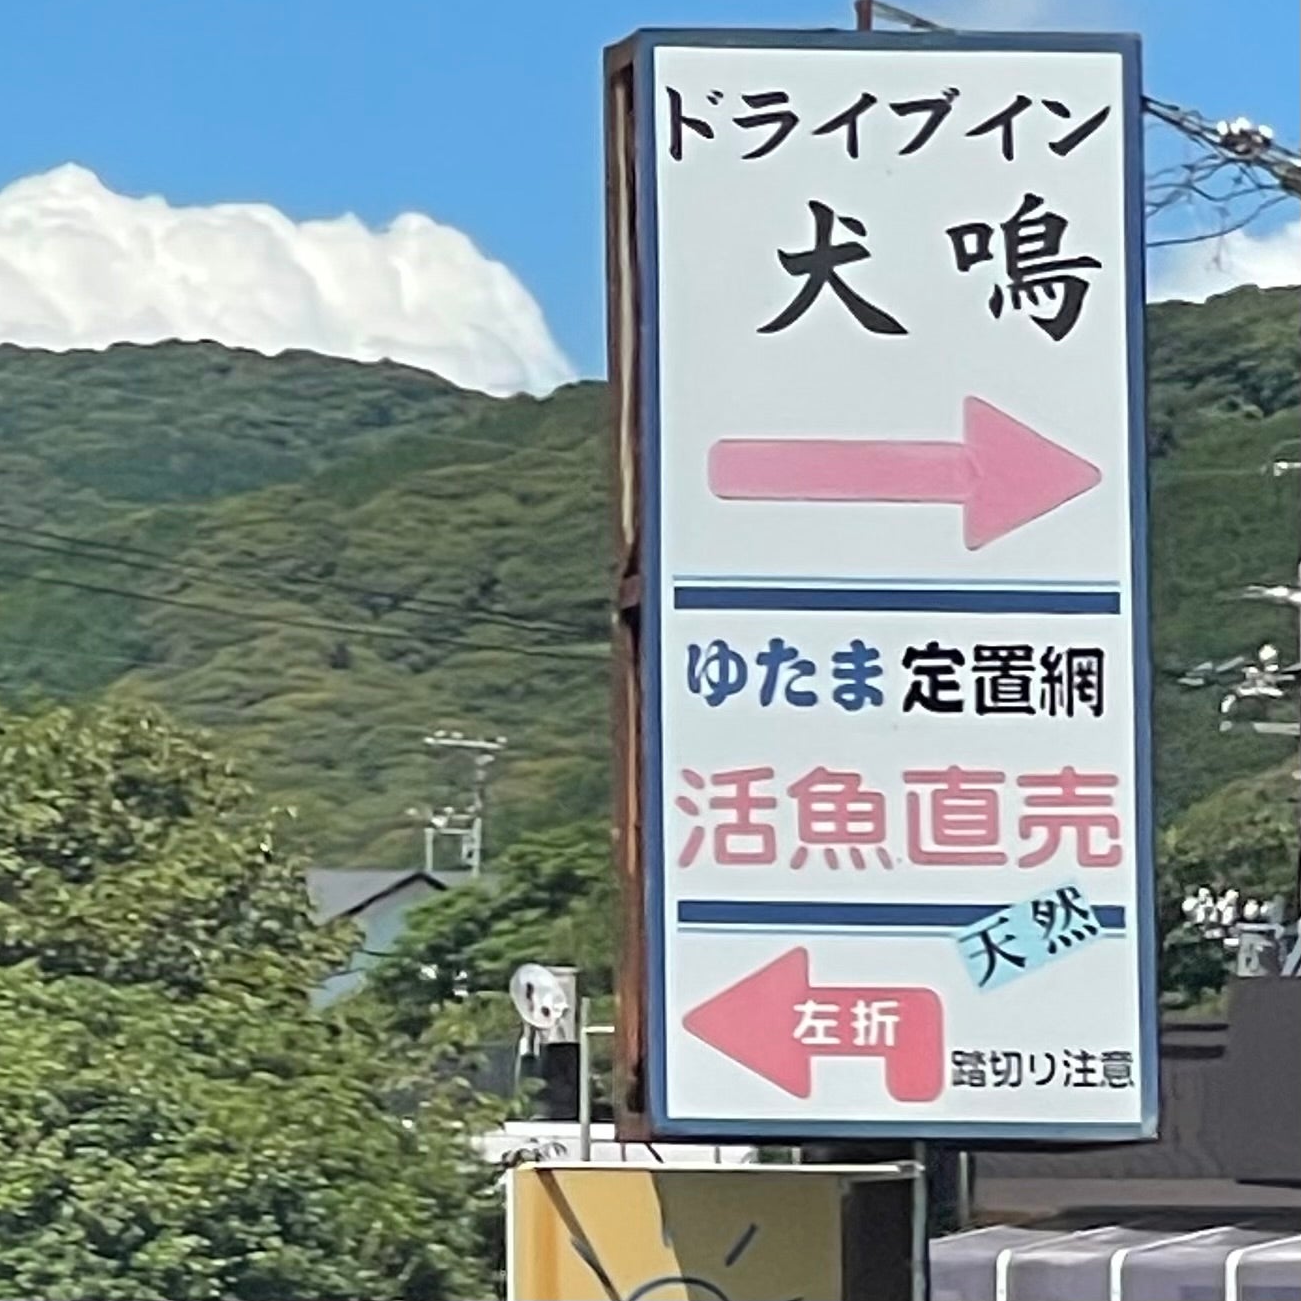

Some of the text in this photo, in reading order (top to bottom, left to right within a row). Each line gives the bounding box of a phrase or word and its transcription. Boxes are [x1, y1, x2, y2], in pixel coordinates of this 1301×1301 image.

[665, 86, 1112, 161] ドライブイン
[757, 193, 1102, 342] 犬鳴
[674, 765, 1123, 870] 活魚直売
[959, 886, 1101, 987] 天然
[793, 1000, 902, 1047] 左折
[951, 1049, 1136, 1089] 踏切り注意
